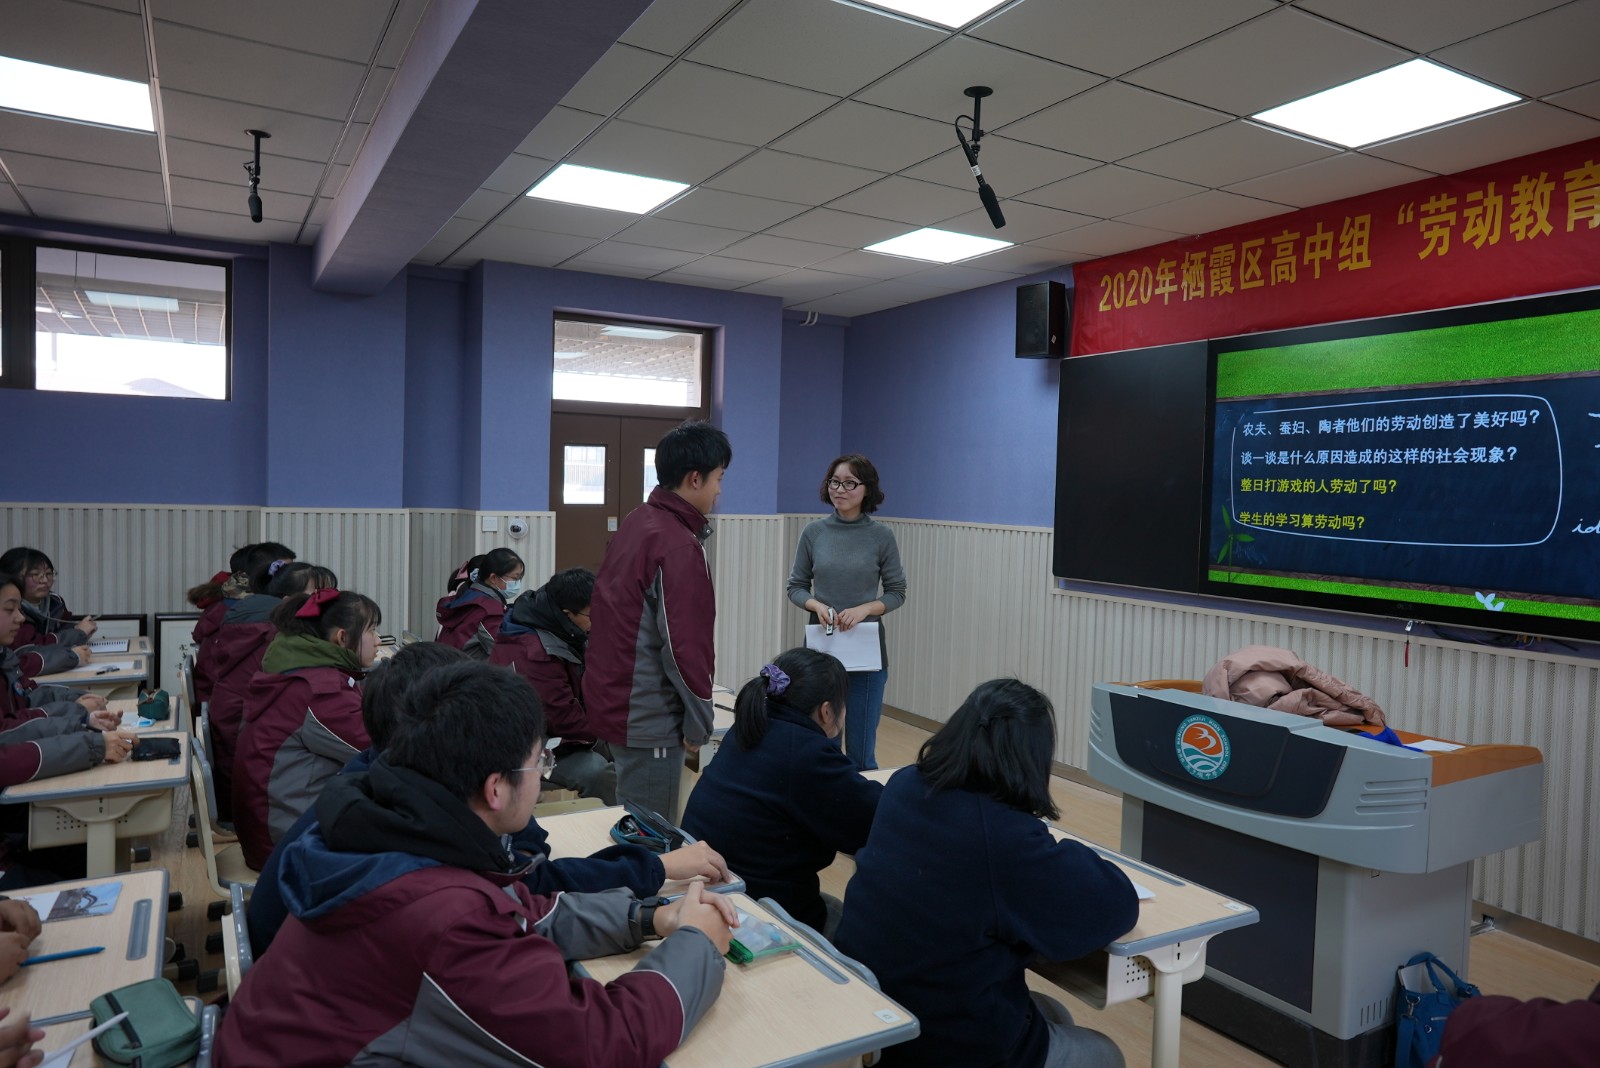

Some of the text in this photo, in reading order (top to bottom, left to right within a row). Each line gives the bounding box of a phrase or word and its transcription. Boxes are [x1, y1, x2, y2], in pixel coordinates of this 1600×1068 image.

[1099, 214, 1372, 312] 2020年栖霞区高中组
[1242, 409, 1540, 437] 农夫、蚕妇、陶者他们的劳动创造了美好吗？
[1240, 446, 1518, 466] 谈一谈是什么原因造成的这样的社会现象？
[1240, 477, 1398, 495] 整日打游戏的人劳动了吗？
[1239, 511, 1366, 531] 学生的学习算劳动吗？
